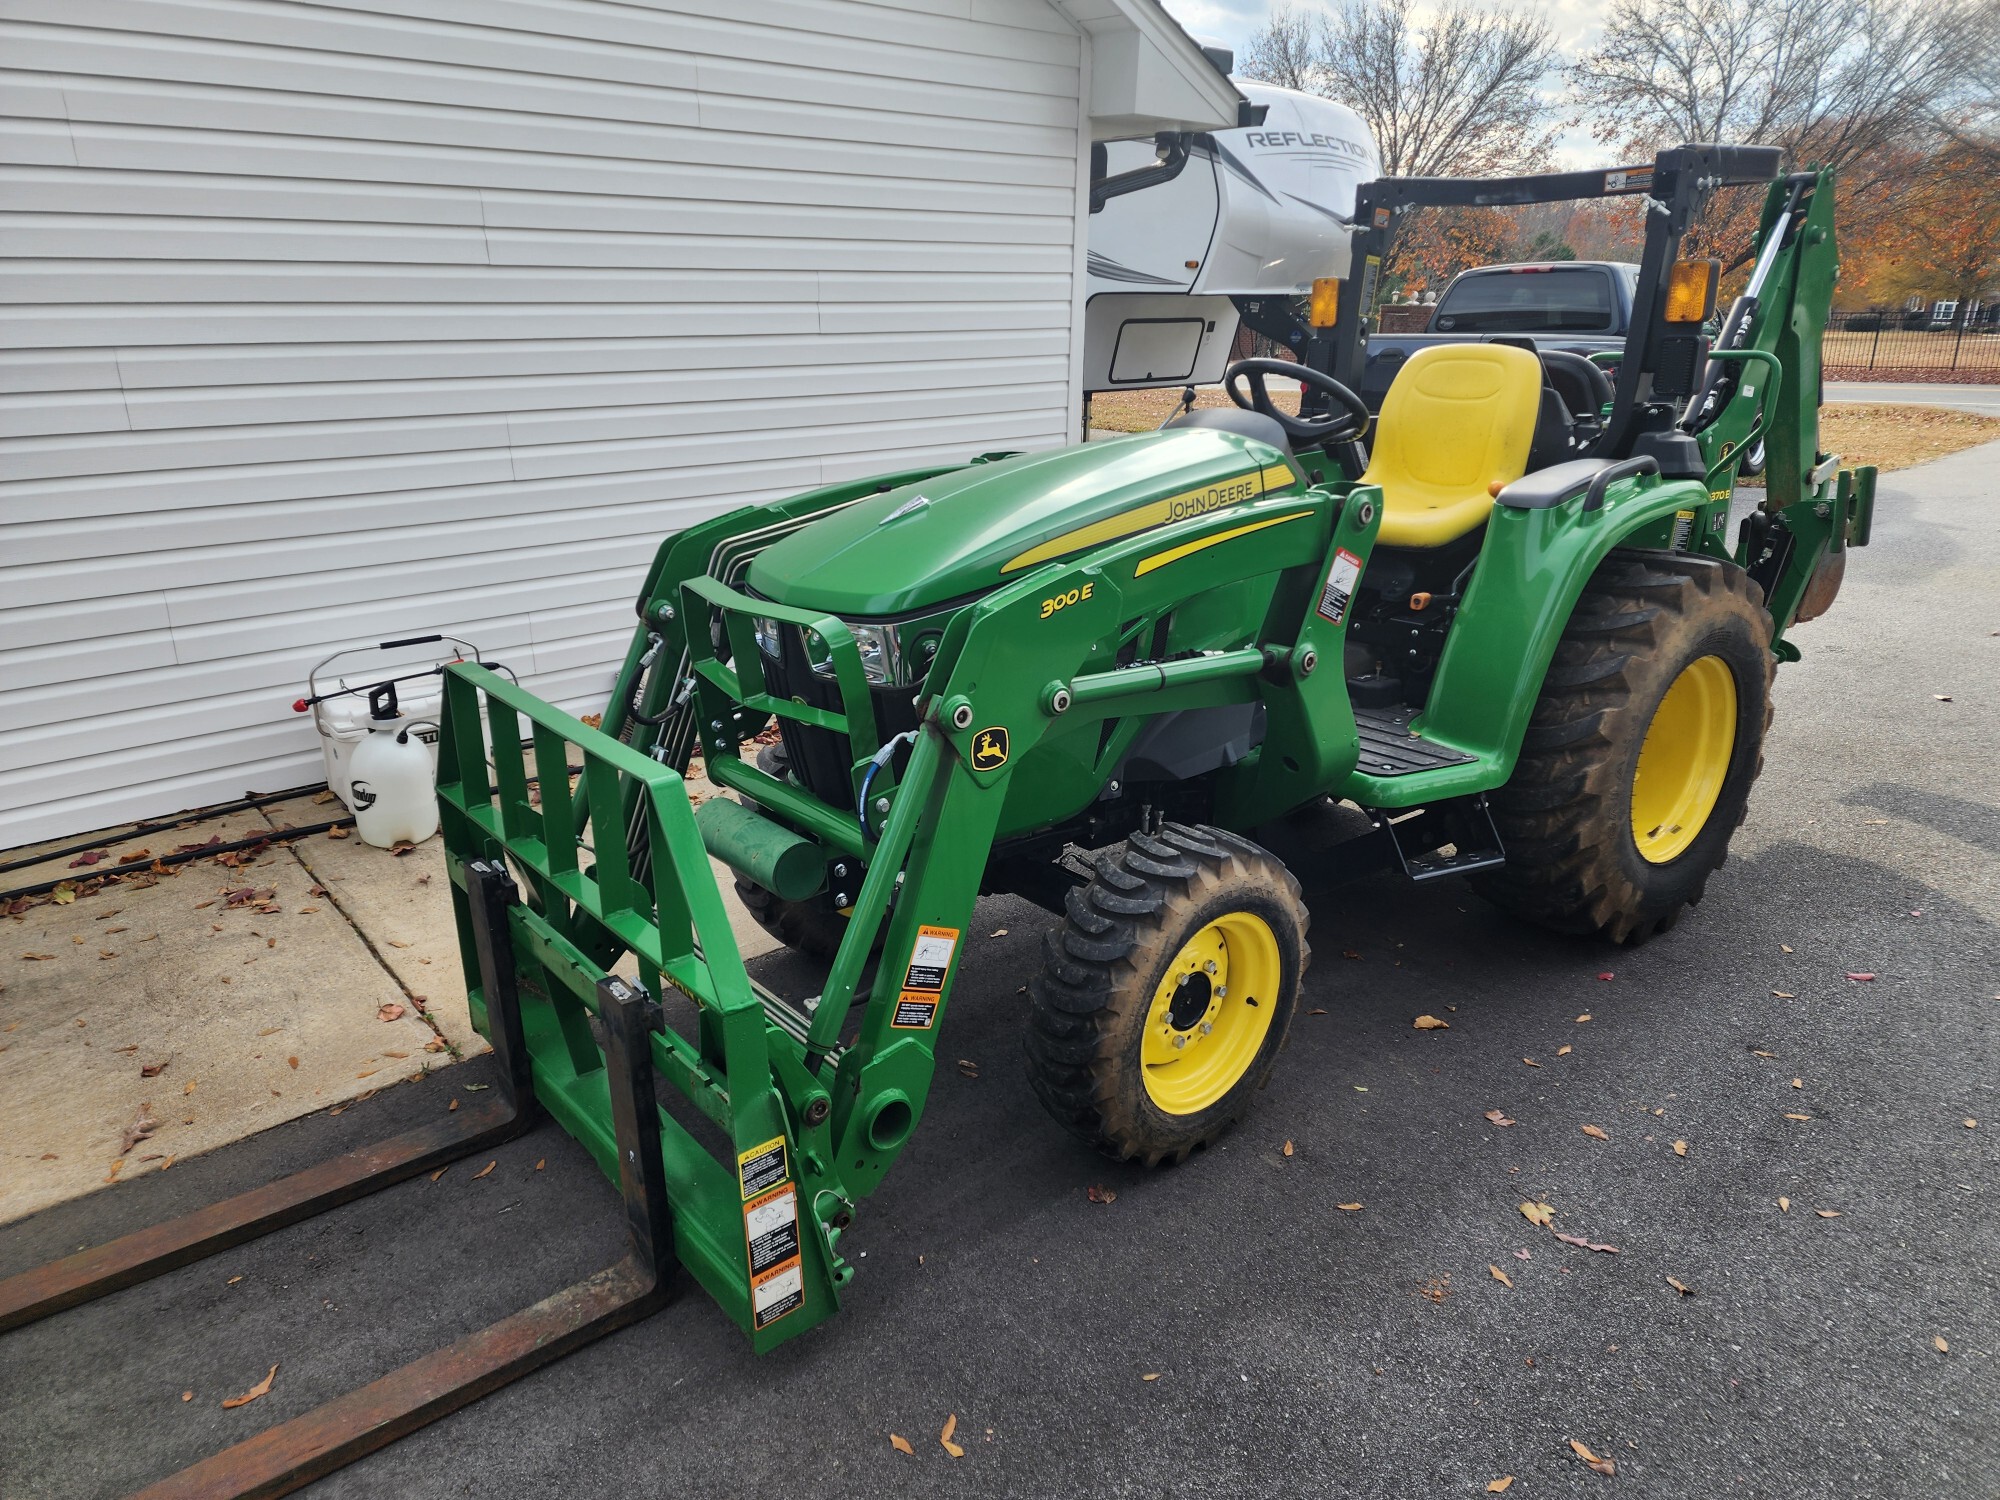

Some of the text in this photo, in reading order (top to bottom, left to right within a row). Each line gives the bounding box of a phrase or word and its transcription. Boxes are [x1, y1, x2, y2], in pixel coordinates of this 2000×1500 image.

[1245, 132, 1375, 161] REFLECTION
[1165, 481, 1253, 521] JOHN DEERE
[929, 929, 954, 938] WARNING
[910, 995, 935, 1003] WARNING
[750, 1140, 780, 1158] CAUTION
[756, 1187, 789, 1207] WARNING
[764, 1261, 795, 1280] WARNING
